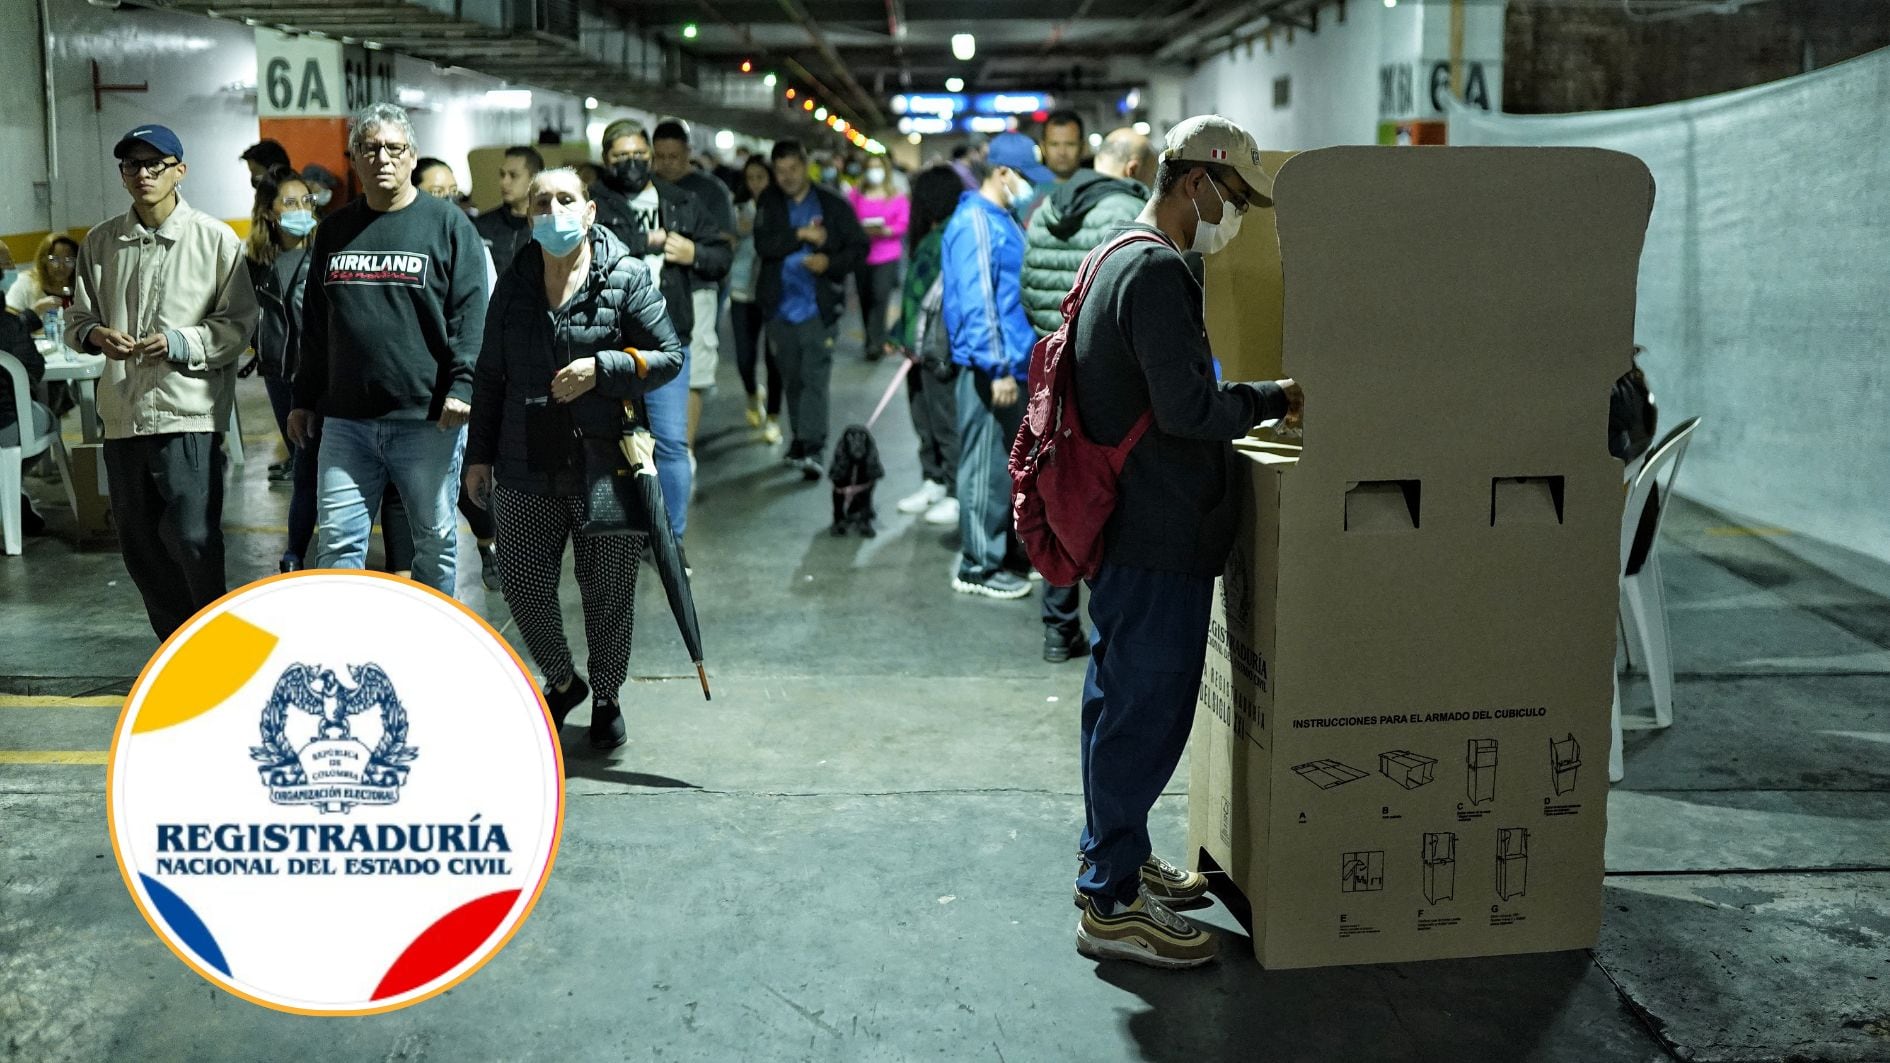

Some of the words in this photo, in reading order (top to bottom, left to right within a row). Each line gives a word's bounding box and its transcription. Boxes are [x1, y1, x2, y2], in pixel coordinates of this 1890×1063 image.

[266, 57, 330, 111] 6A
[329, 255, 423, 273] KIRKLAND
[1212, 690, 1231, 728] SIGLO
[1292, 716, 1378, 729] INSTRUCCIONES
[1380, 714, 1408, 725] PARA
[1409, 713, 1423, 724] EL
[1424, 711, 1471, 723] ARMADO
[1471, 709, 1493, 721] DEL
[1494, 706, 1547, 720] CUBICULO
